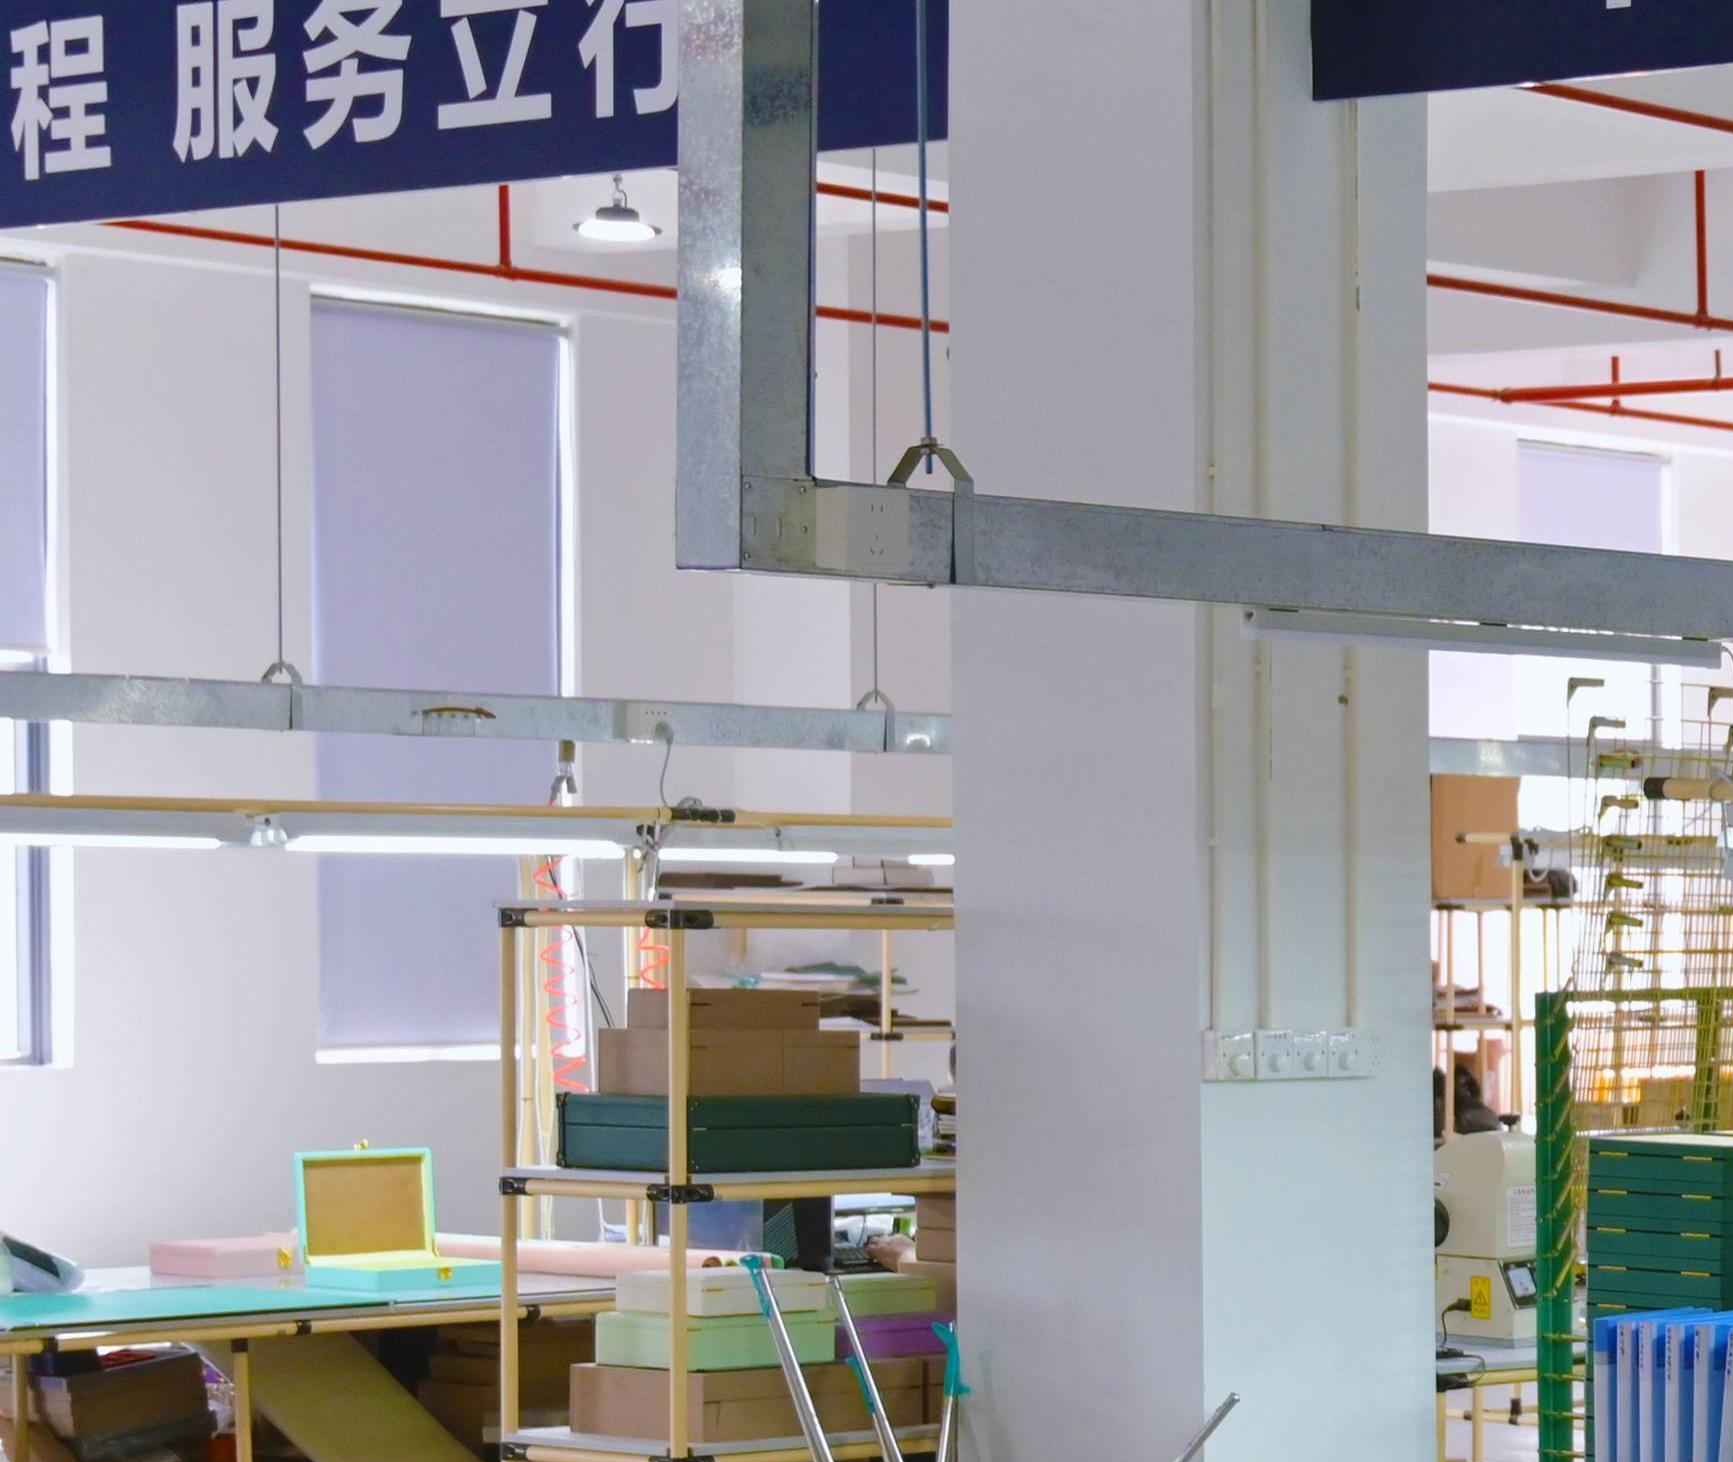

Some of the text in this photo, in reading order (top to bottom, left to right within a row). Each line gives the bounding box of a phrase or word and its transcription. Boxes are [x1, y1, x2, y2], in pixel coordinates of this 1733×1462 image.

[10, 0, 680, 181] 程 服务立行
